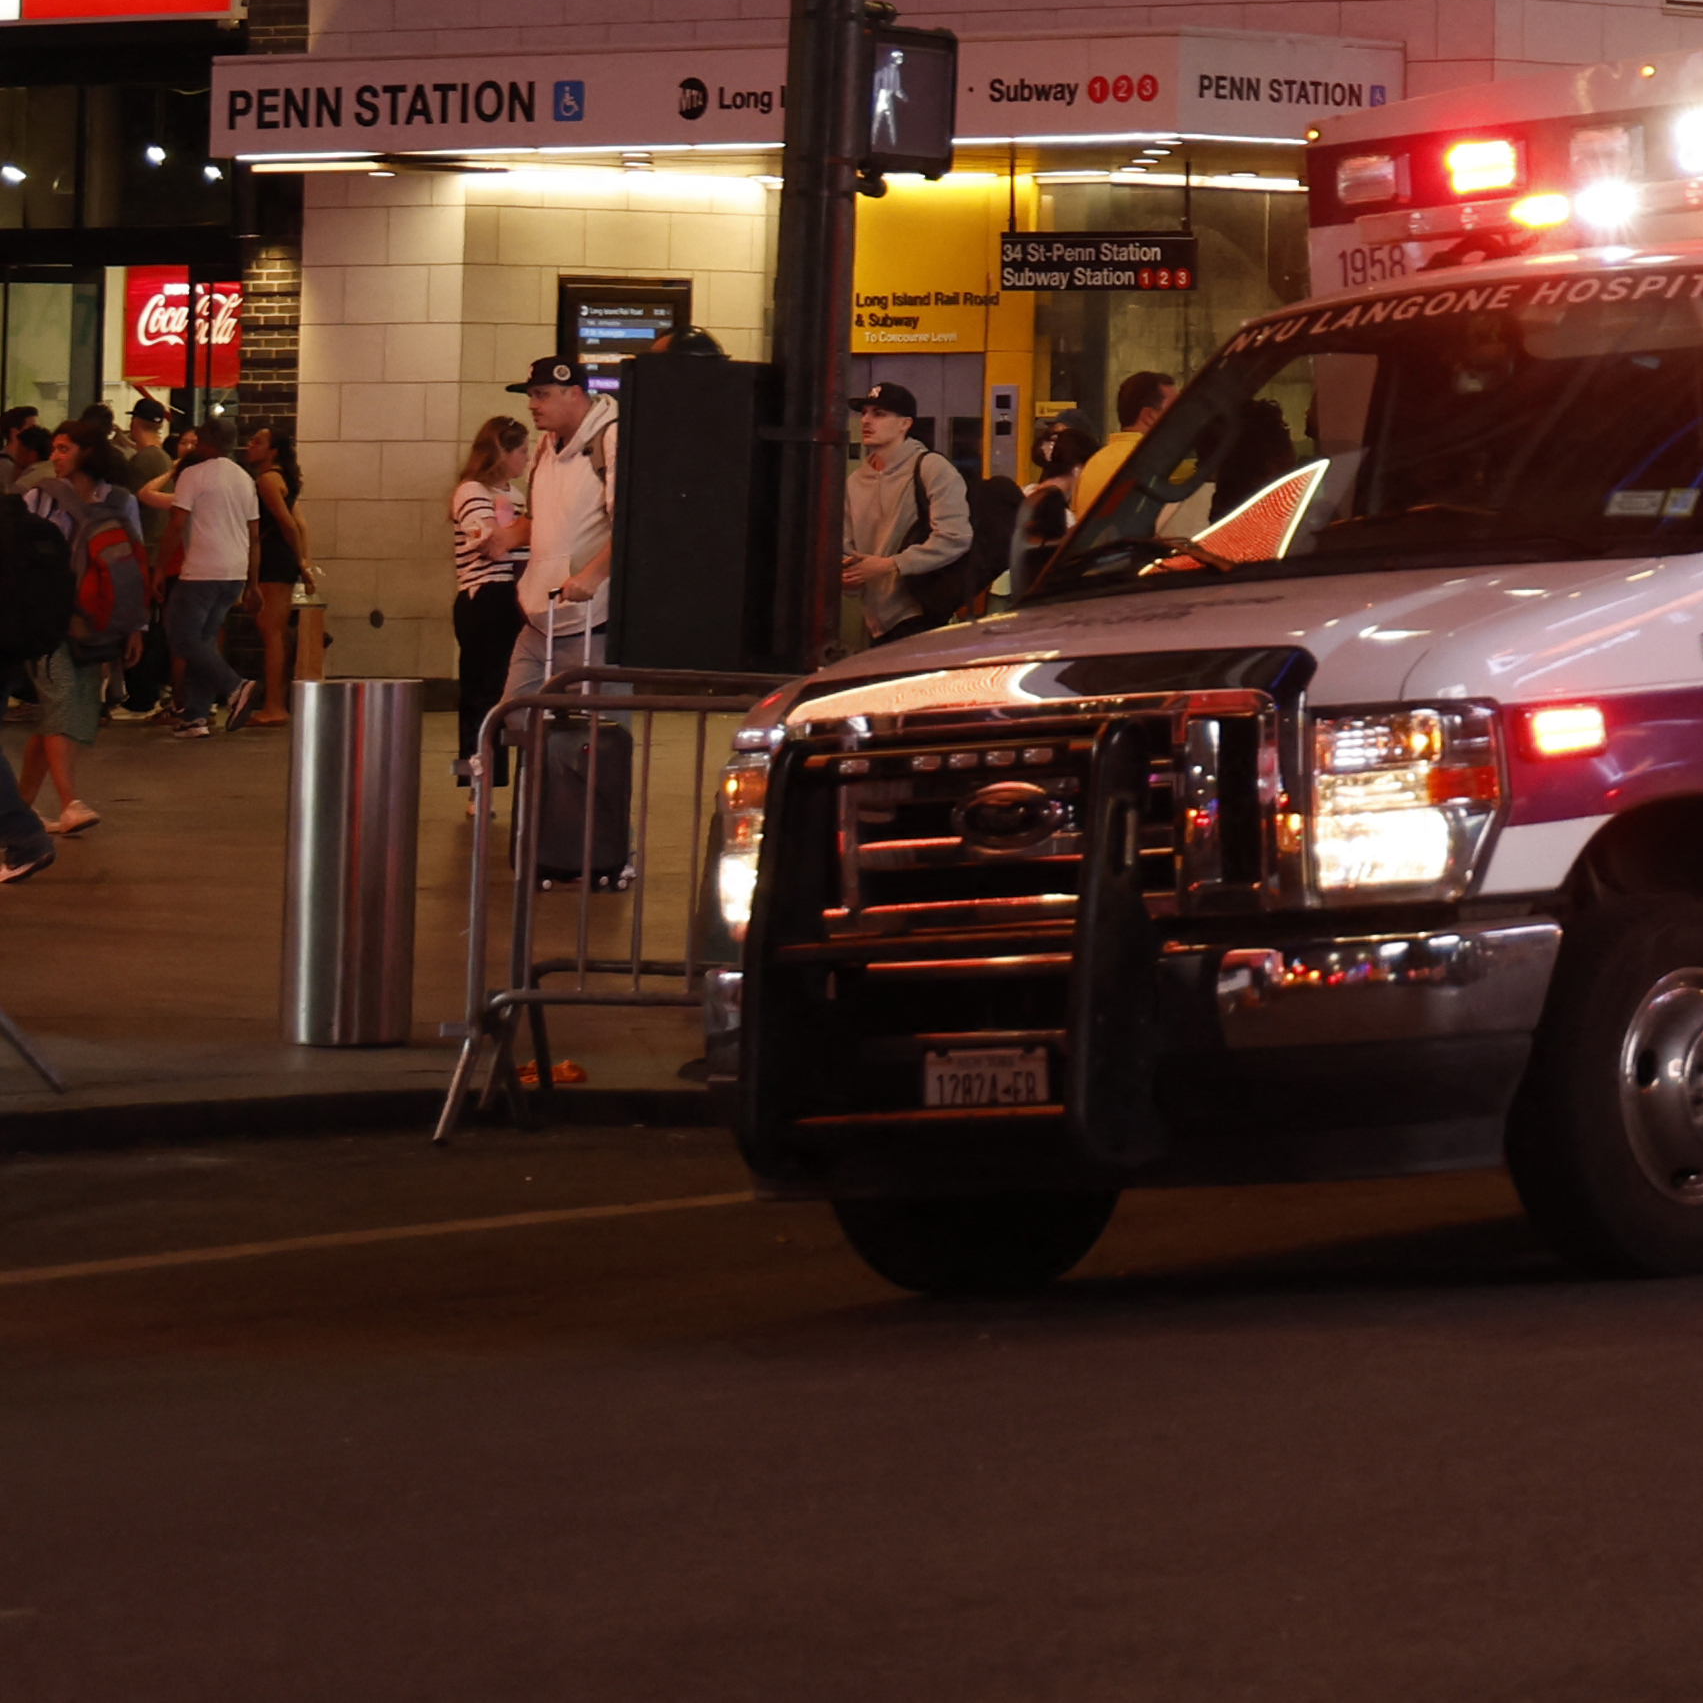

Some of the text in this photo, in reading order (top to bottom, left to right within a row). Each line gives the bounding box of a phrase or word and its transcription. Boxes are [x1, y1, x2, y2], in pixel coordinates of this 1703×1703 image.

[228, 80, 537, 130] PENN STATION
[718, 85, 773, 114] Long
[989, 77, 1079, 106] Subway
[1198, 74, 1364, 108] PENN STATION
[1002, 242, 1161, 262] 34 St-Penn Station
[1002, 267, 1070, 289] Subway
[1073, 267, 1135, 286] Station
[1337, 247, 1407, 288] 1958
[856, 291, 1000, 311] Long Island Rail Road
[868, 313, 919, 330] Subway
[1222, 317, 1310, 357] NYU
[1309, 282, 1522, 335] LANGONE
